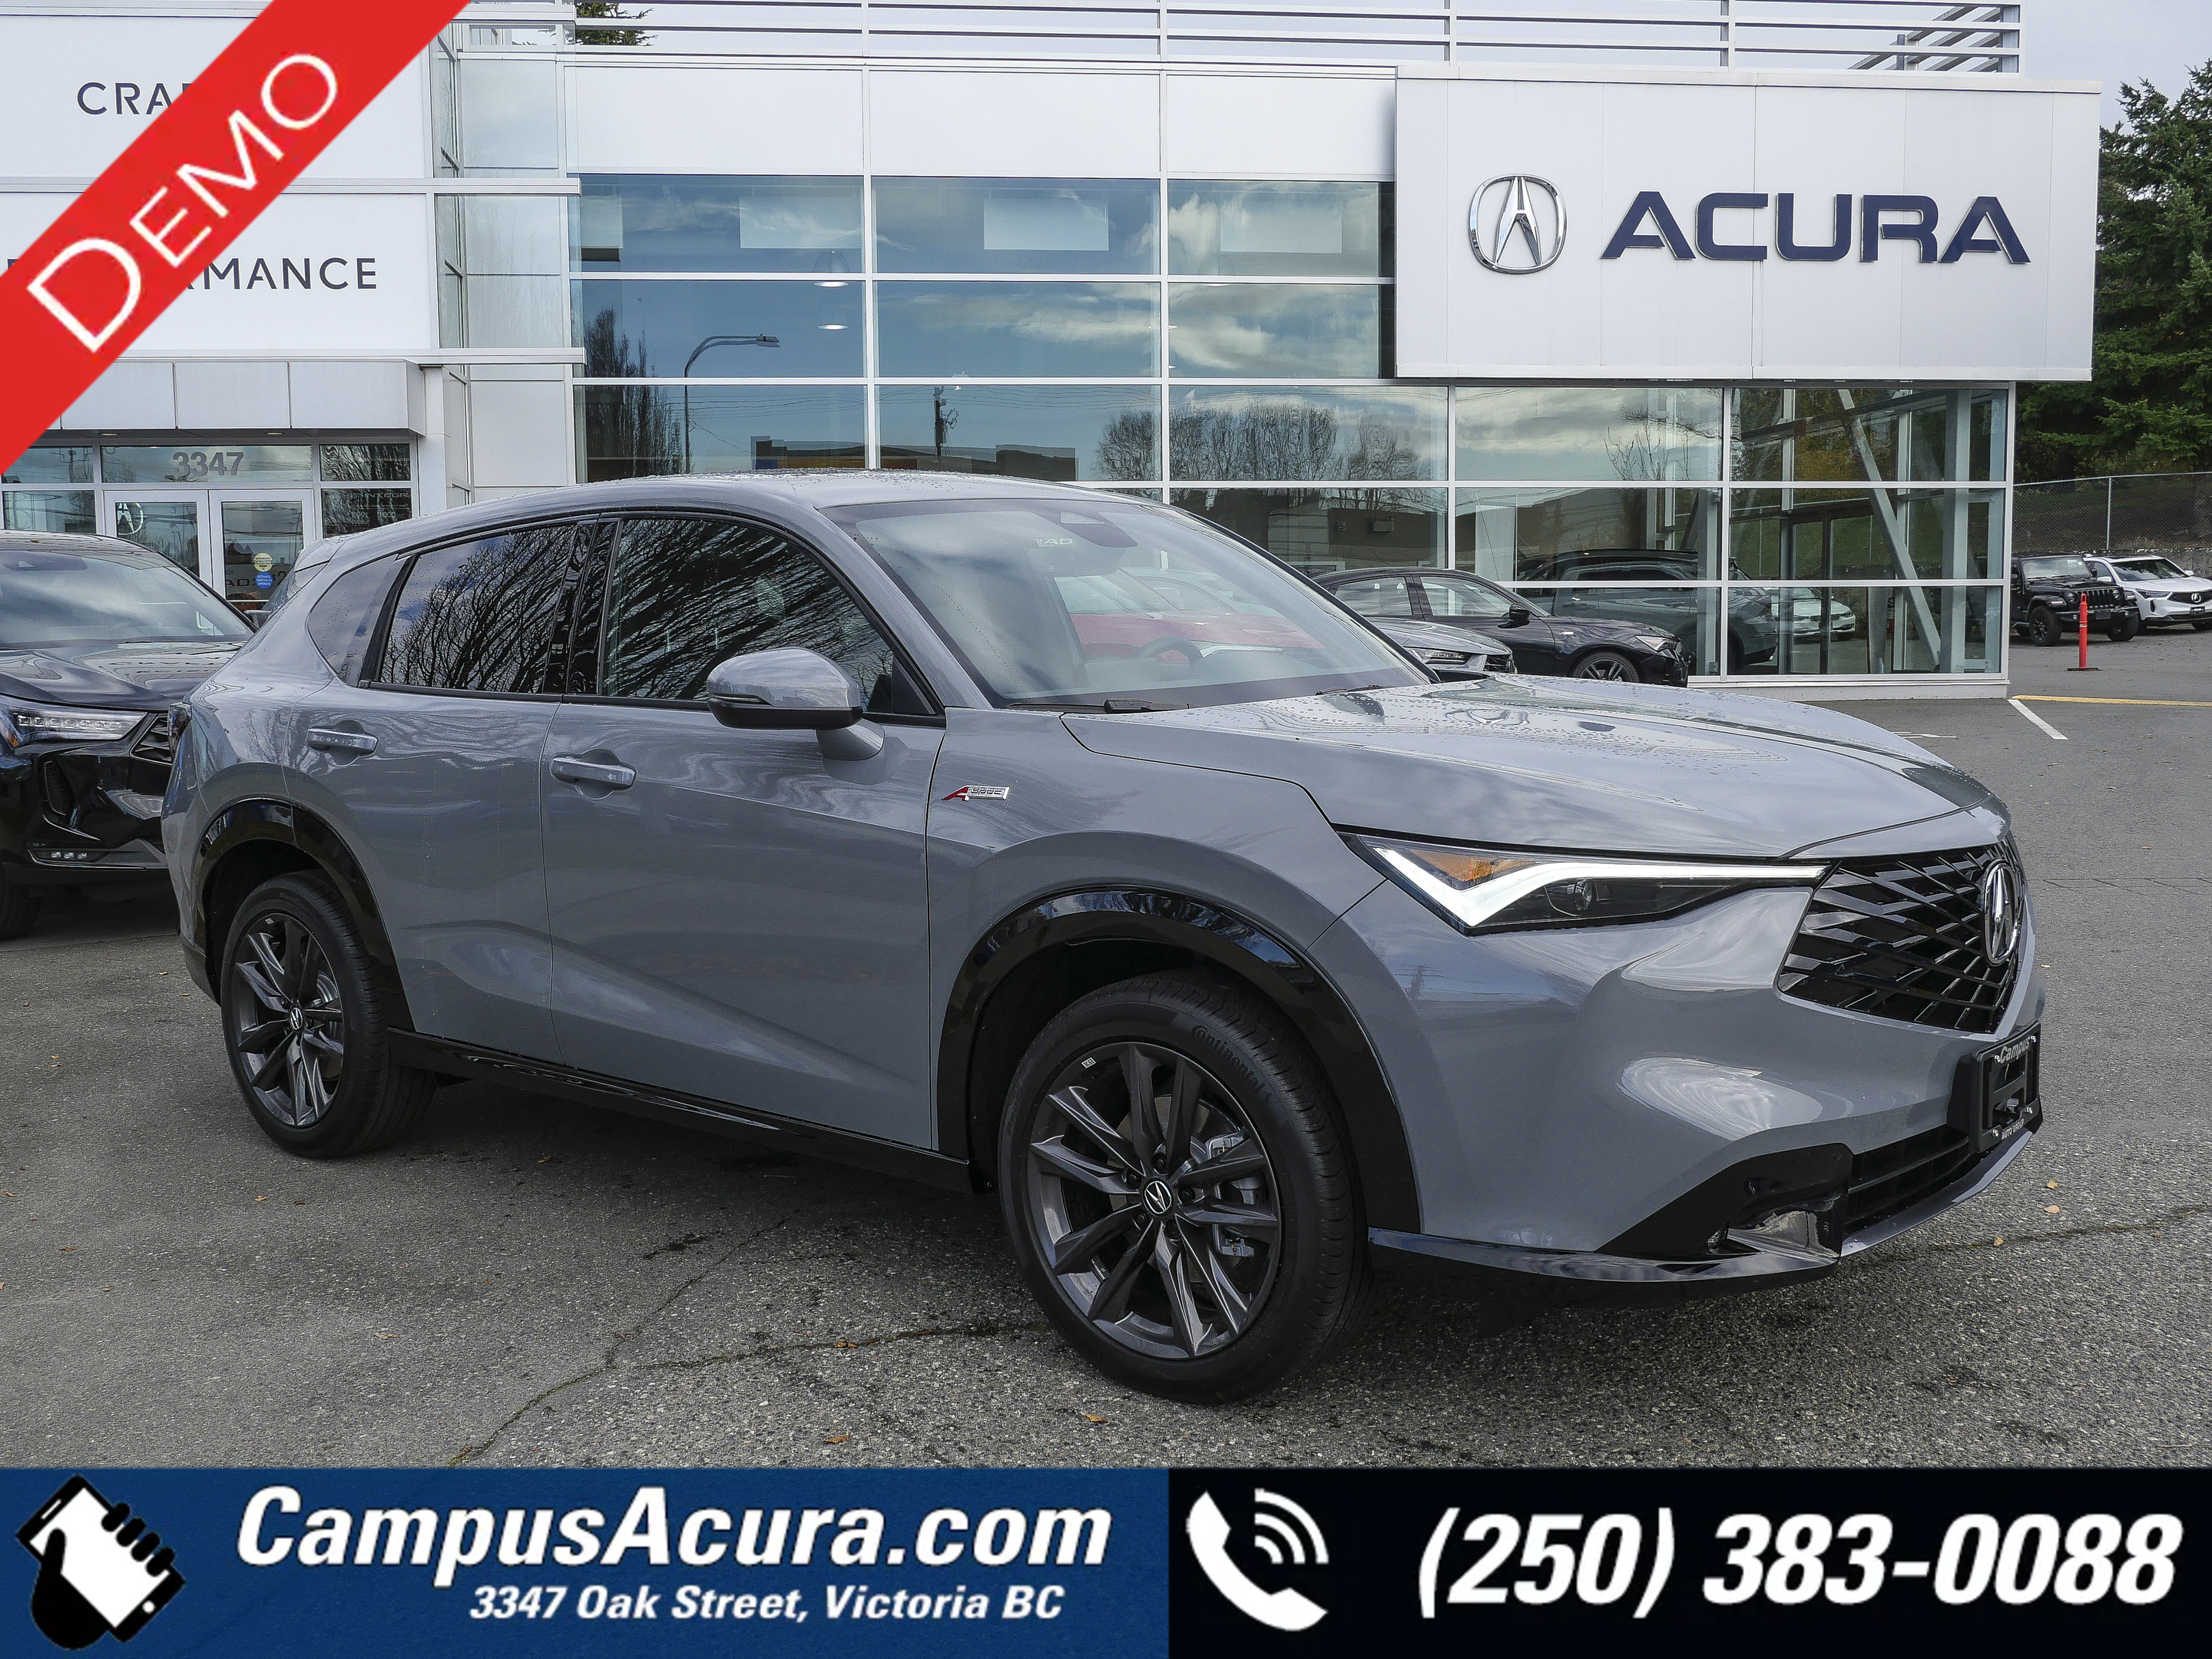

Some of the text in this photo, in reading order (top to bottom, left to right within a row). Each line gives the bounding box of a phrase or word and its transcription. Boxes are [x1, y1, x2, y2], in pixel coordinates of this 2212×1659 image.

[77, 81, 191, 115] CRA
[1600, 190, 2032, 264] ACURA
[187, 257, 377, 290] MANCE
[172, 451, 244, 477] 3347
[2000, 1036, 2030, 1064] Campus
